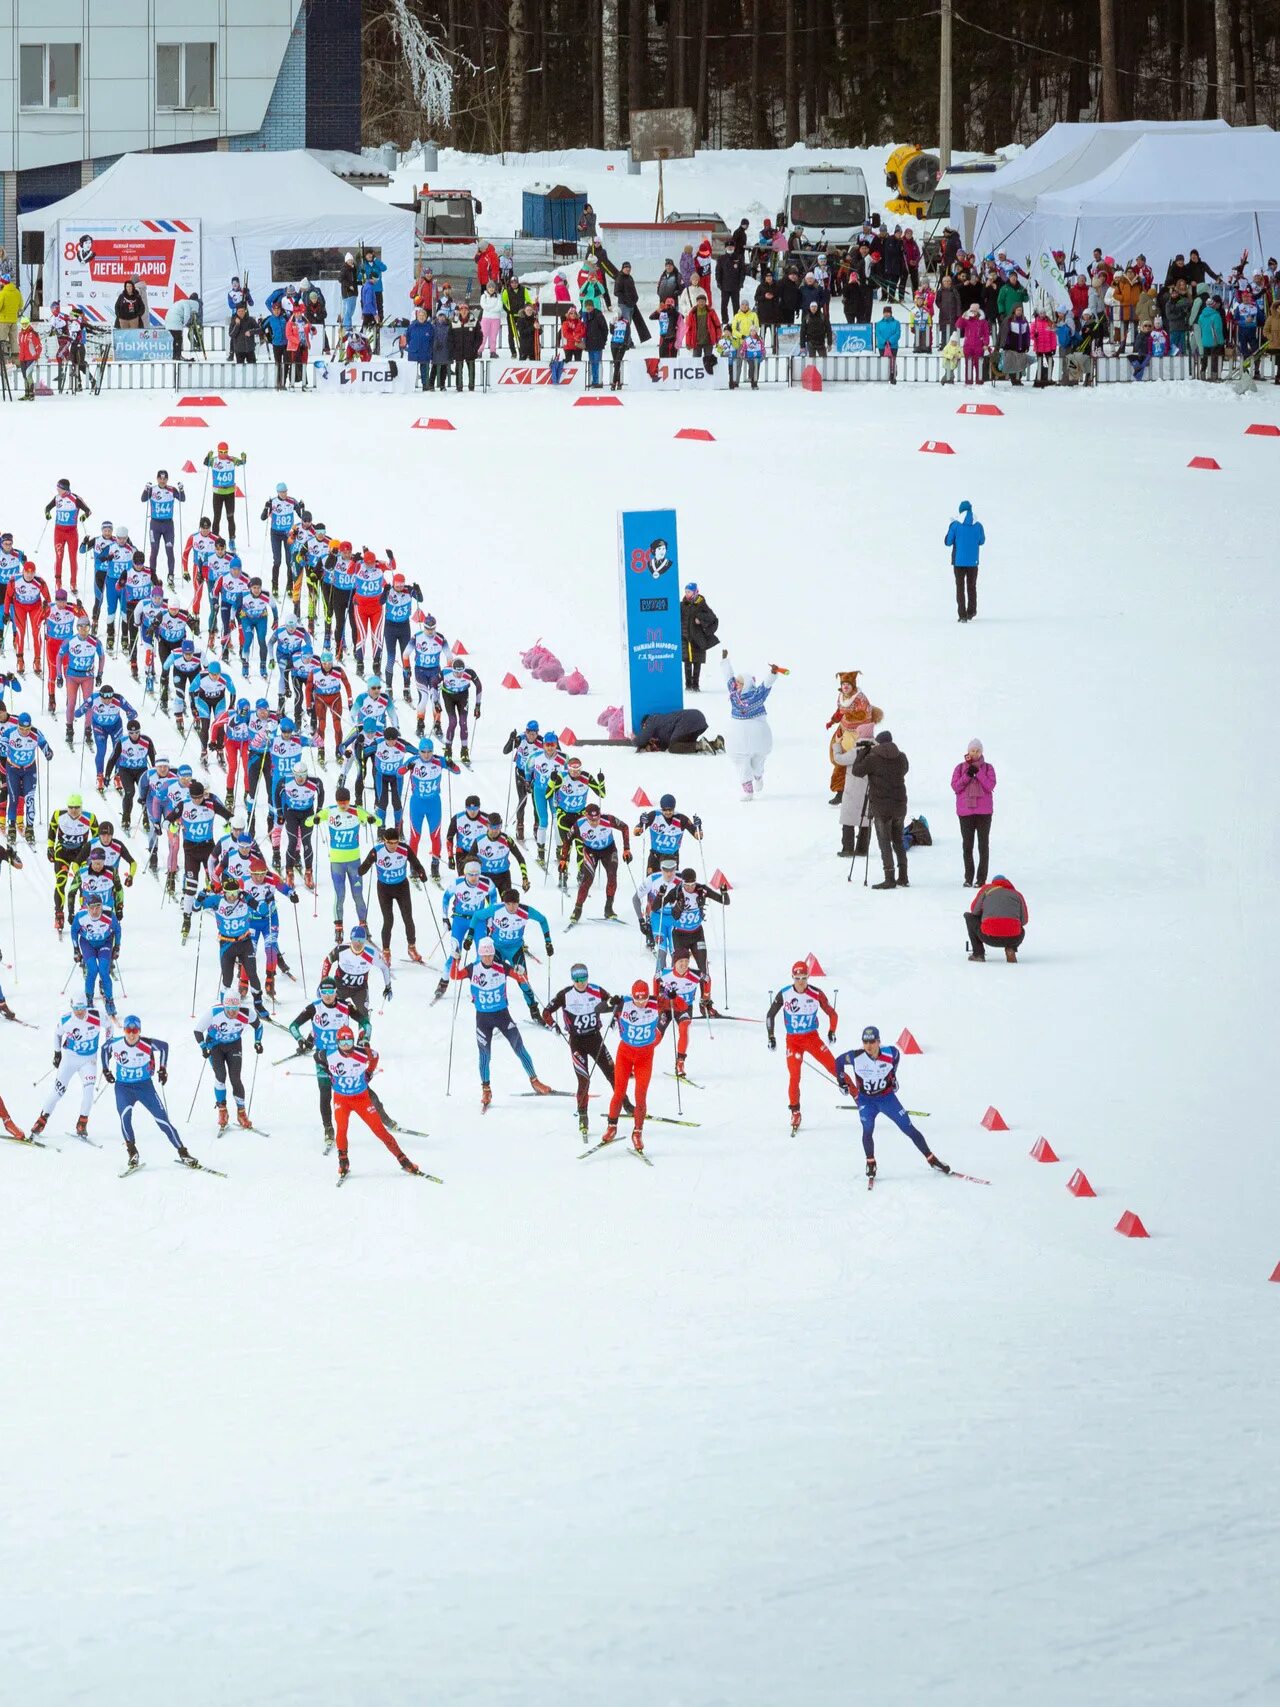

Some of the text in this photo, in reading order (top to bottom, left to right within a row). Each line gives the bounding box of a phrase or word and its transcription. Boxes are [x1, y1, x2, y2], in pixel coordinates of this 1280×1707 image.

[93, 262, 166, 275] ЛЕГЕН...ДАРНО
[115, 341, 170, 351] ЛЫЖНЫ
[143, 351, 170, 360] ГОНК
[361, 371, 393, 382] ПСБ
[673, 368, 705, 380] ПСБ
[217, 472, 232, 482] 460
[155, 503, 171, 513] 544
[361, 581, 380, 593] 403
[391, 607, 408, 618] 463
[73, 656, 91, 667] 452
[13, 750, 32, 761] 429
[419, 782, 437, 792] 534
[564, 796, 583, 806] 462
[188, 823, 209, 835] 467
[333, 831, 354, 842] 477
[655, 835, 677, 848] 449
[342, 976, 364, 986] 470
[574, 1014, 596, 1027] 495
[791, 1015, 813, 1028] 547
[628, 1025, 651, 1038] 525
[321, 1031, 335, 1044] 41
[338, 1076, 361, 1089] 492
